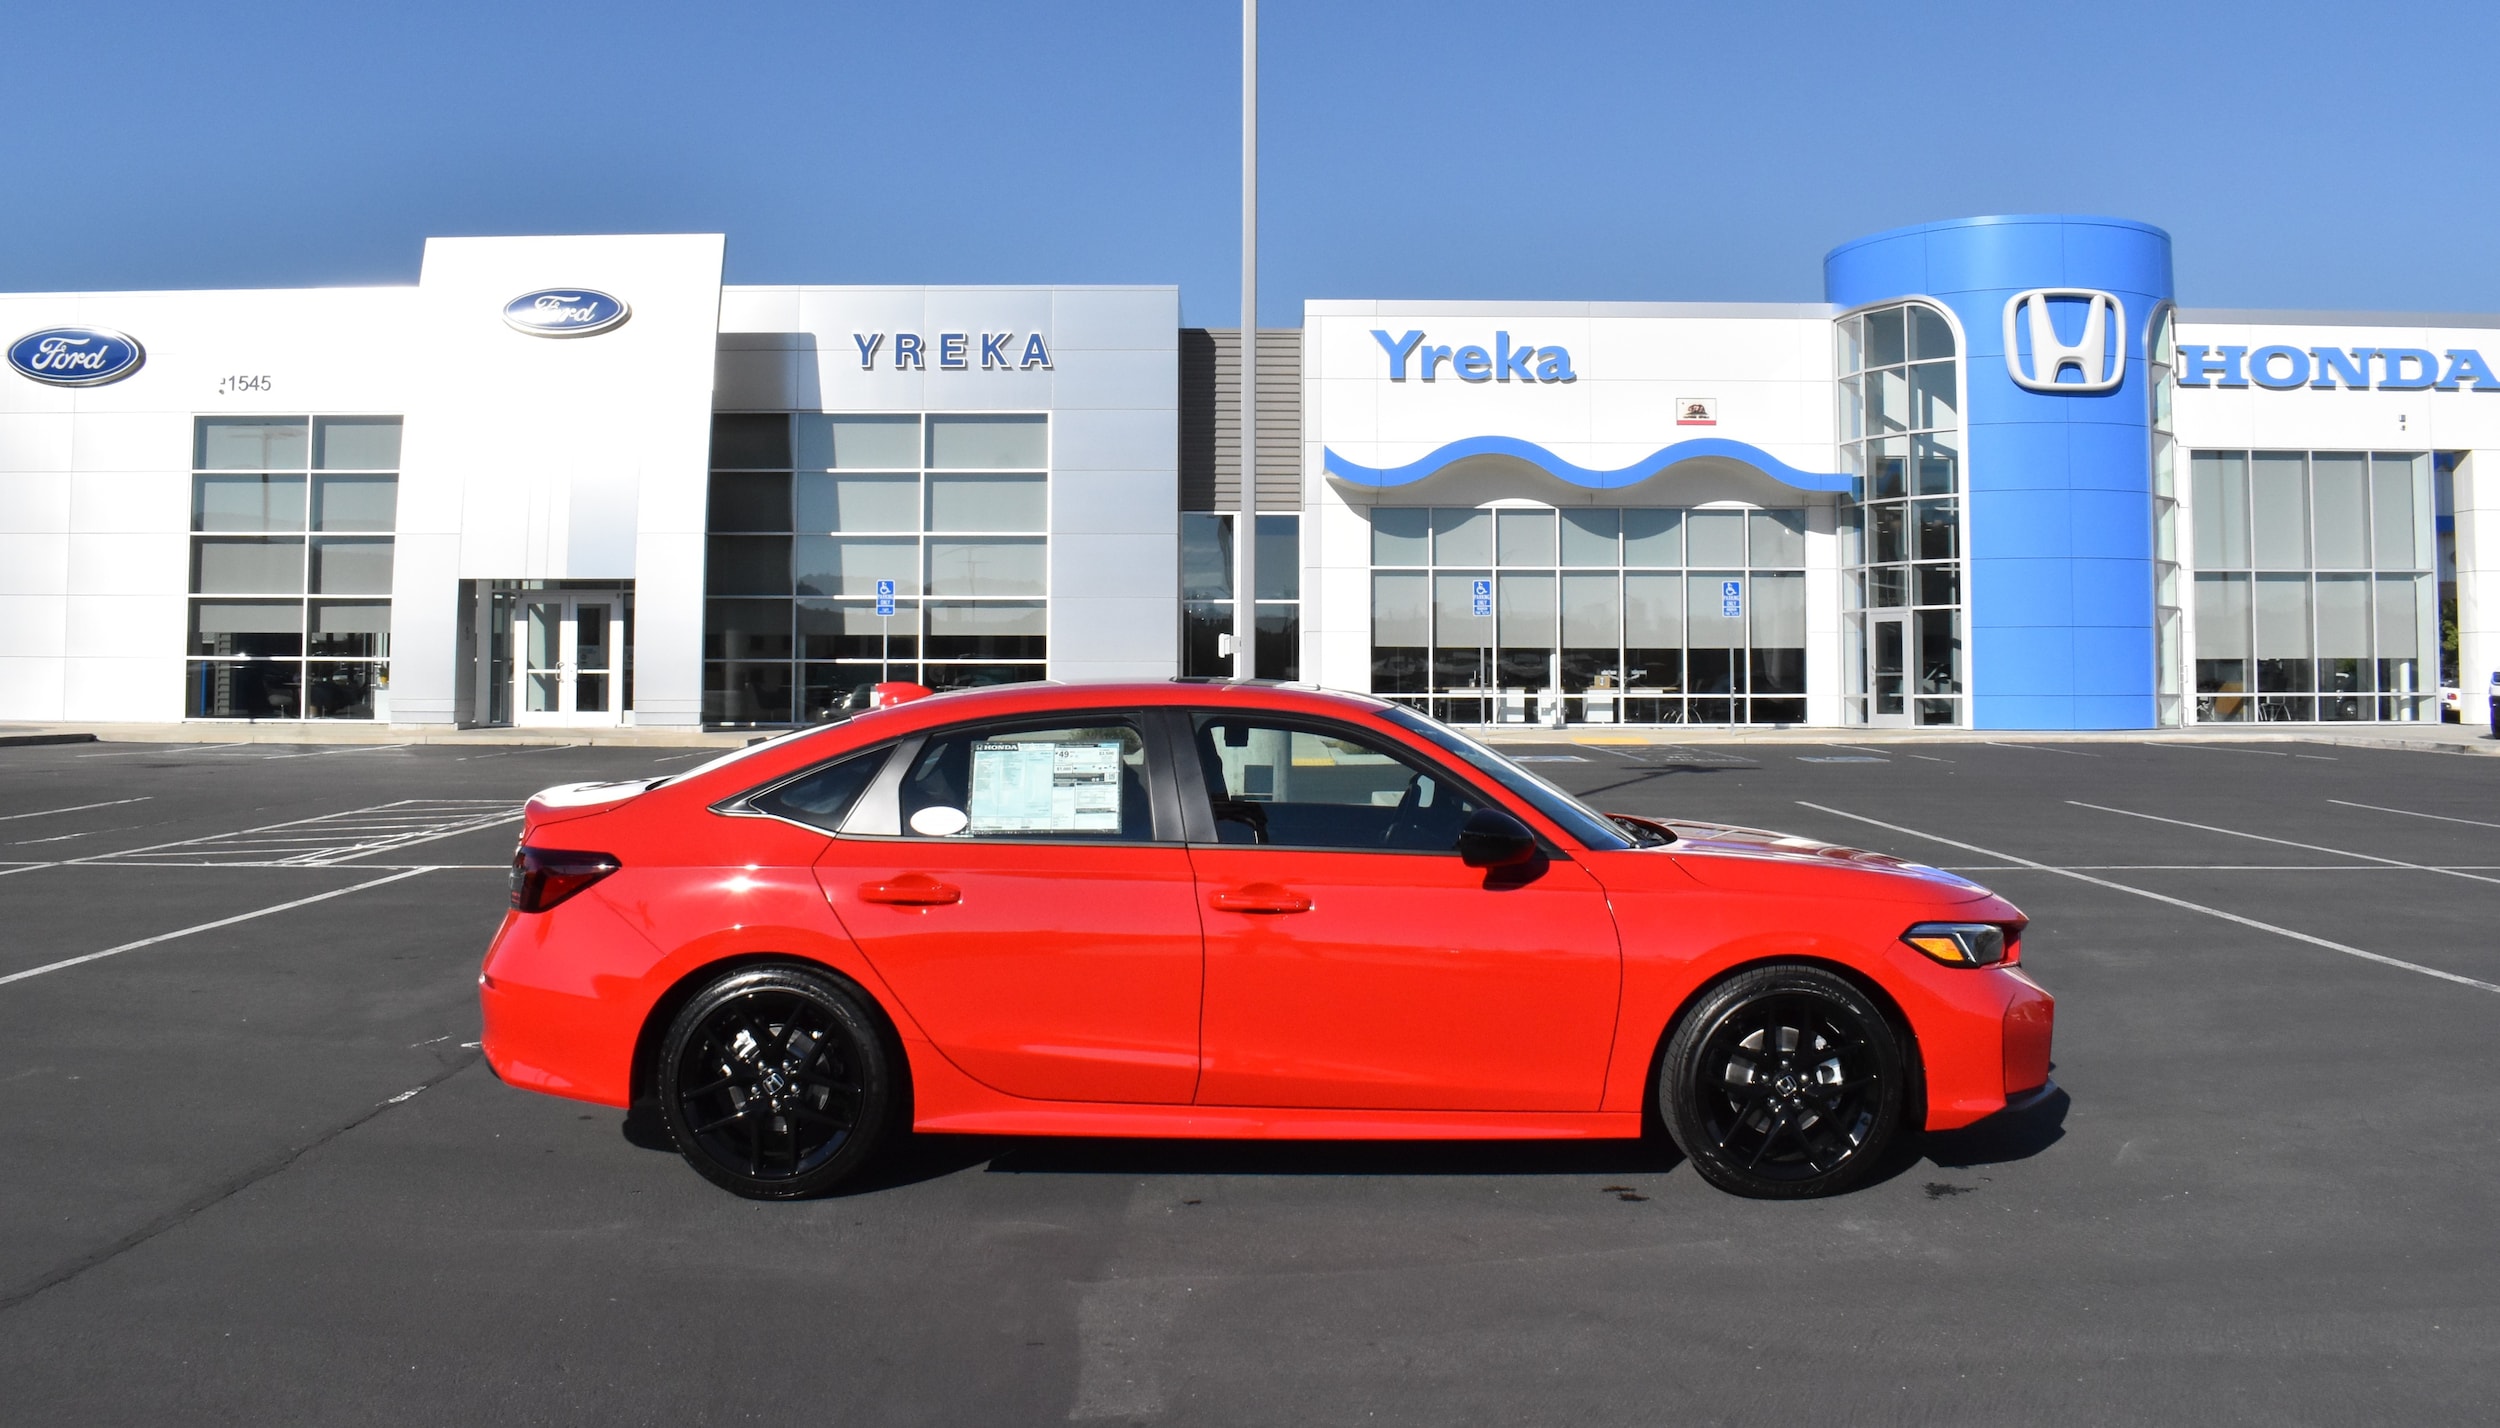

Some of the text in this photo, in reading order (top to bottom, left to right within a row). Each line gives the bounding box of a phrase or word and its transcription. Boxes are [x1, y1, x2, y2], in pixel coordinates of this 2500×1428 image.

[530, 295, 599, 323] Frd
[31, 337, 108, 370] Ford
[852, 332, 1053, 371] YREKA
[1369, 329, 1577, 384] Yreka
[2176, 344, 2500, 392] HONDA
[228, 375, 272, 392] 1545
